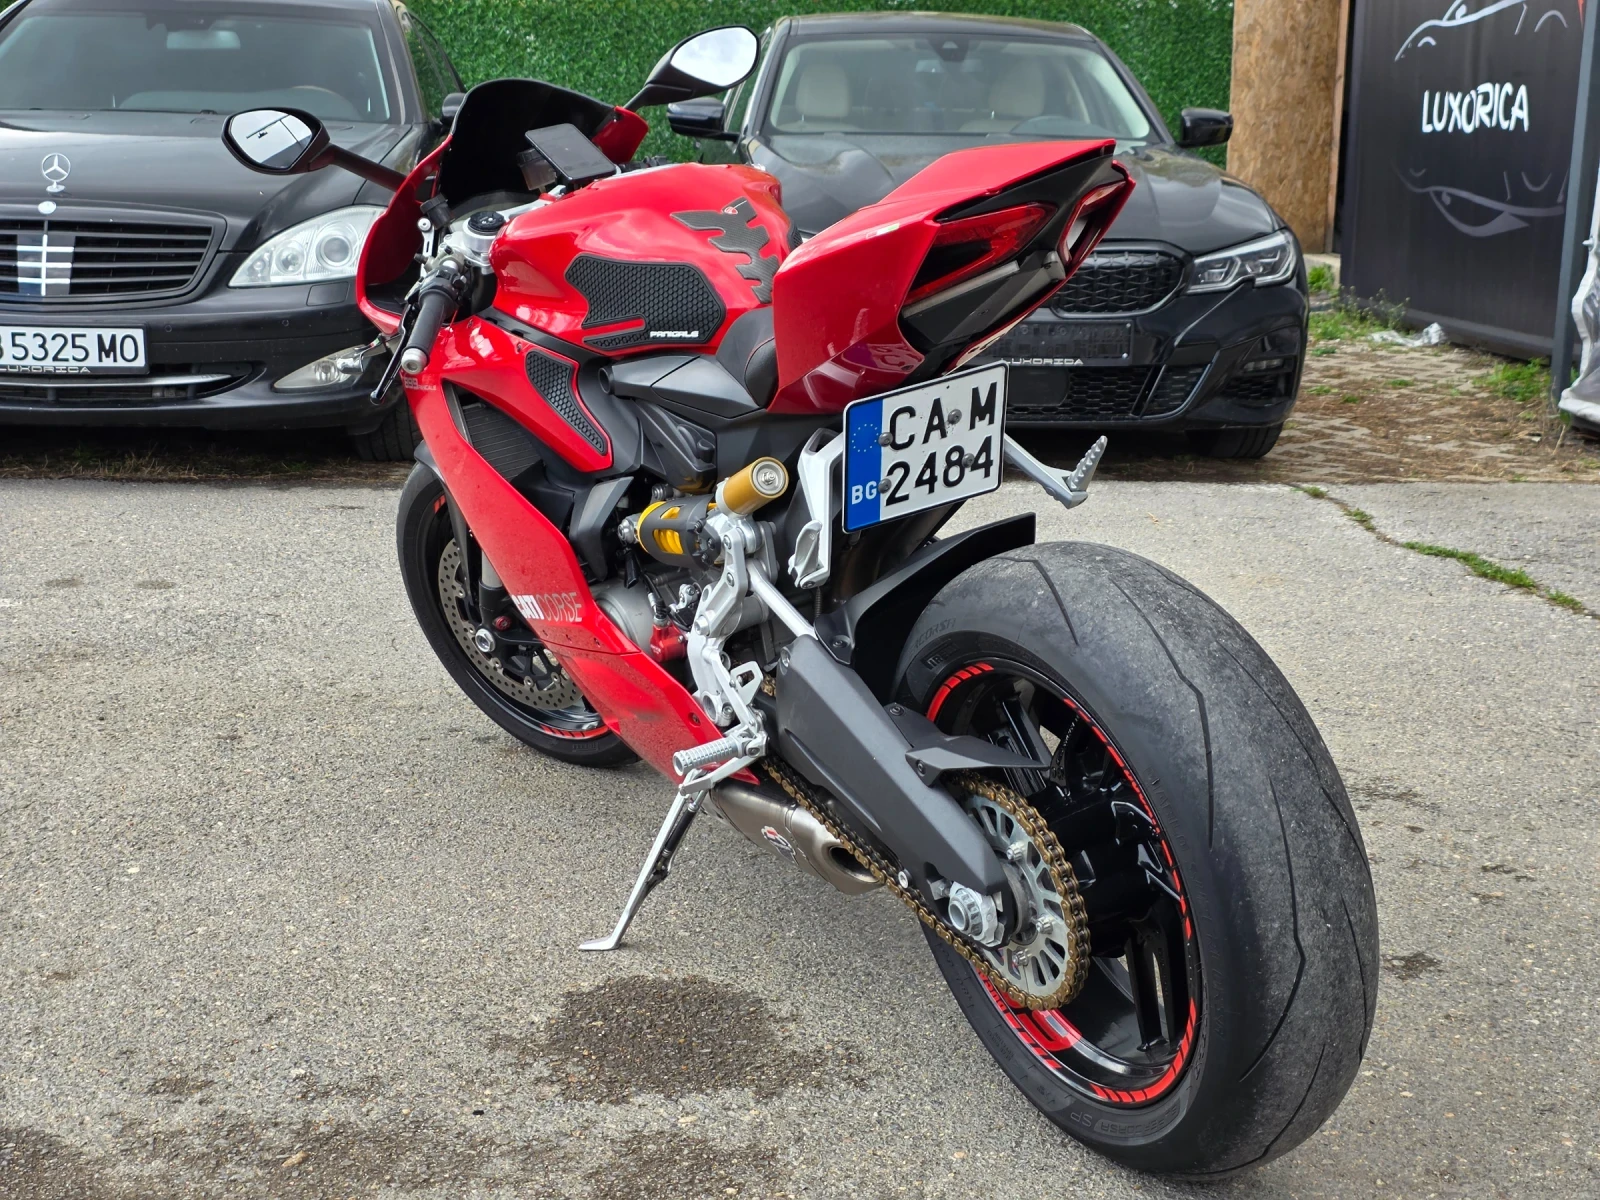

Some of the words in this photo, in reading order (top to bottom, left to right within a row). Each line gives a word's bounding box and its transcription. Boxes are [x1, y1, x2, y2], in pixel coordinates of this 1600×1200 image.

[1422, 82, 1529, 134] LUXORICA
[11, 332, 90, 362] 5325
[97, 333, 139, 363] MO
[890, 397, 948, 451] CA
[968, 381, 998, 431] M
[885, 435, 994, 507] 2484
[851, 480, 878, 505] BG
[535, 592, 582, 622] CORSE
[1070, 1111, 1093, 1127] SP
